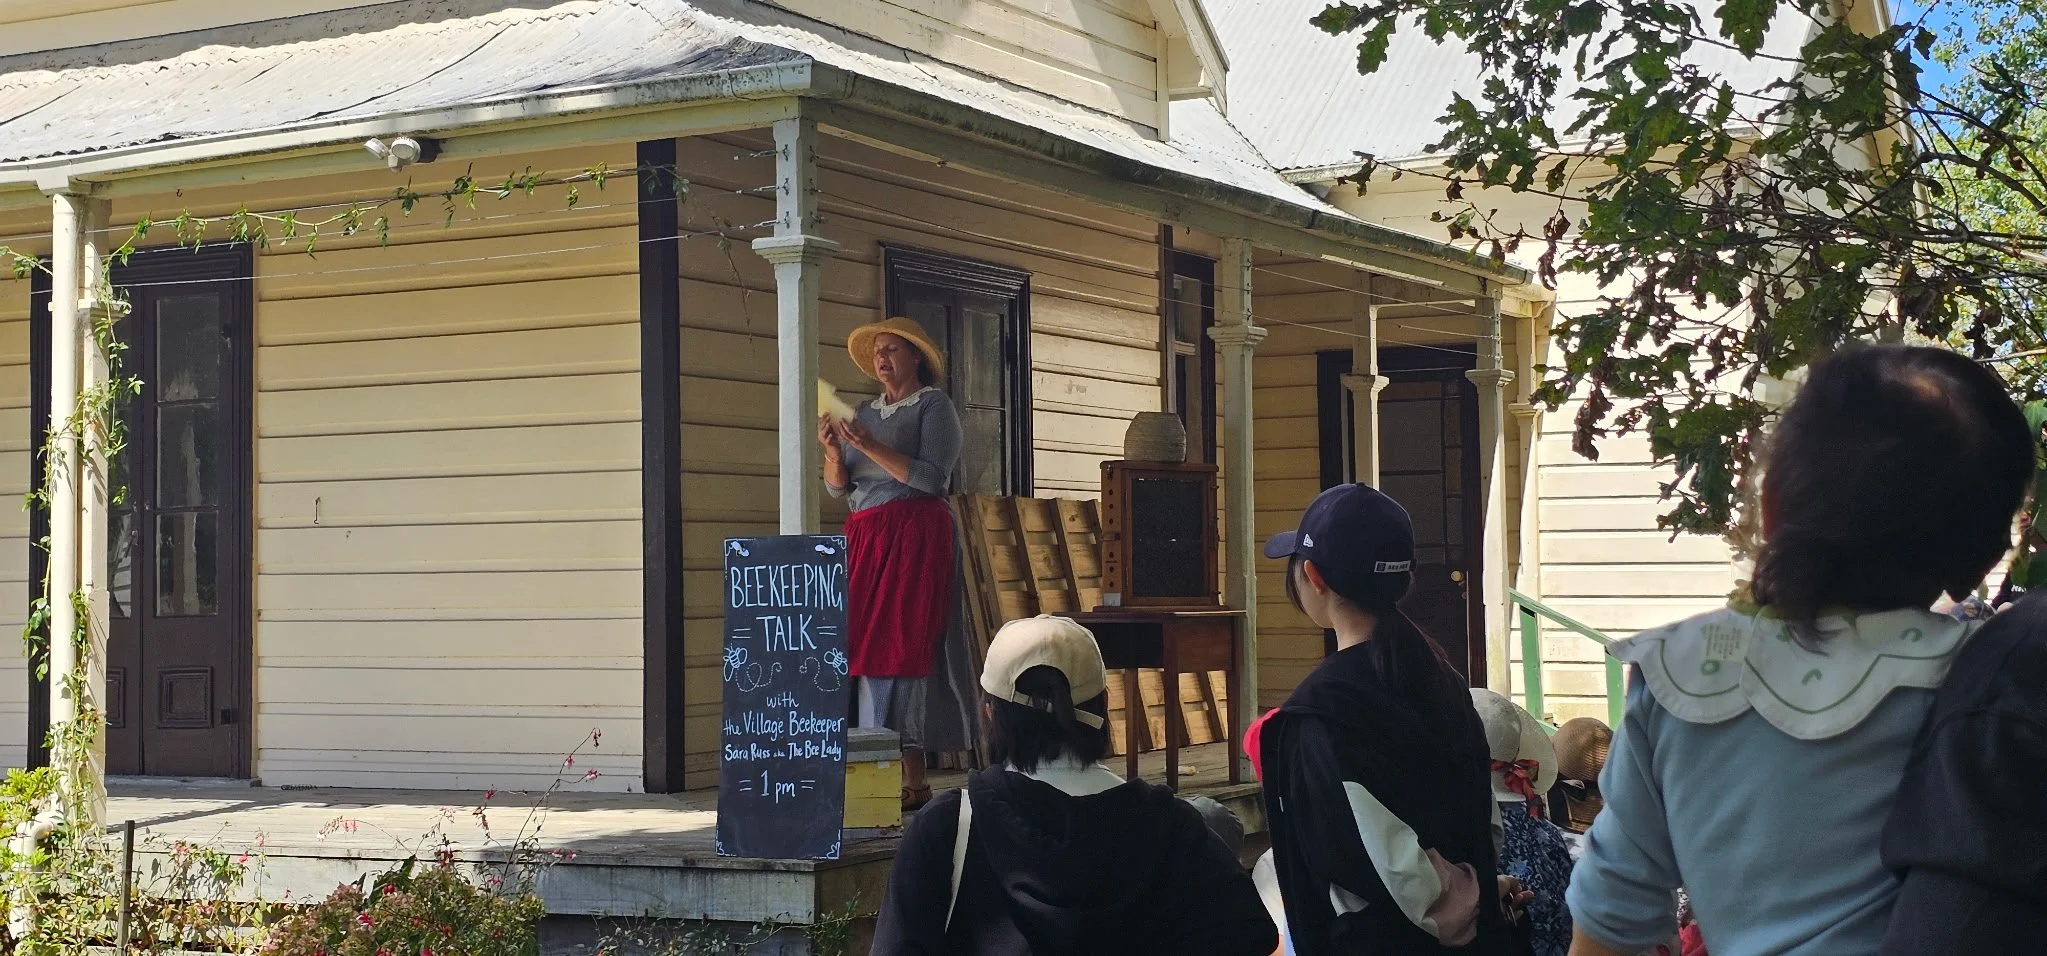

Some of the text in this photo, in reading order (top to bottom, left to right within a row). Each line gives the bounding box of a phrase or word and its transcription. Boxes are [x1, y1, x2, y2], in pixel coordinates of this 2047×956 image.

[731, 563, 843, 611] BEEKEEPING
[756, 614, 817, 652] TALK
[766, 691, 799, 708] with
[723, 710, 845, 742] the Village Beekeeper
[725, 743, 748, 761] Sara
[750, 742, 770, 761] Russ
[787, 742, 803, 760] The
[804, 739, 820, 759] Bee
[820, 739, 842, 762] Lady
[761, 770, 796, 804] 1 pm
